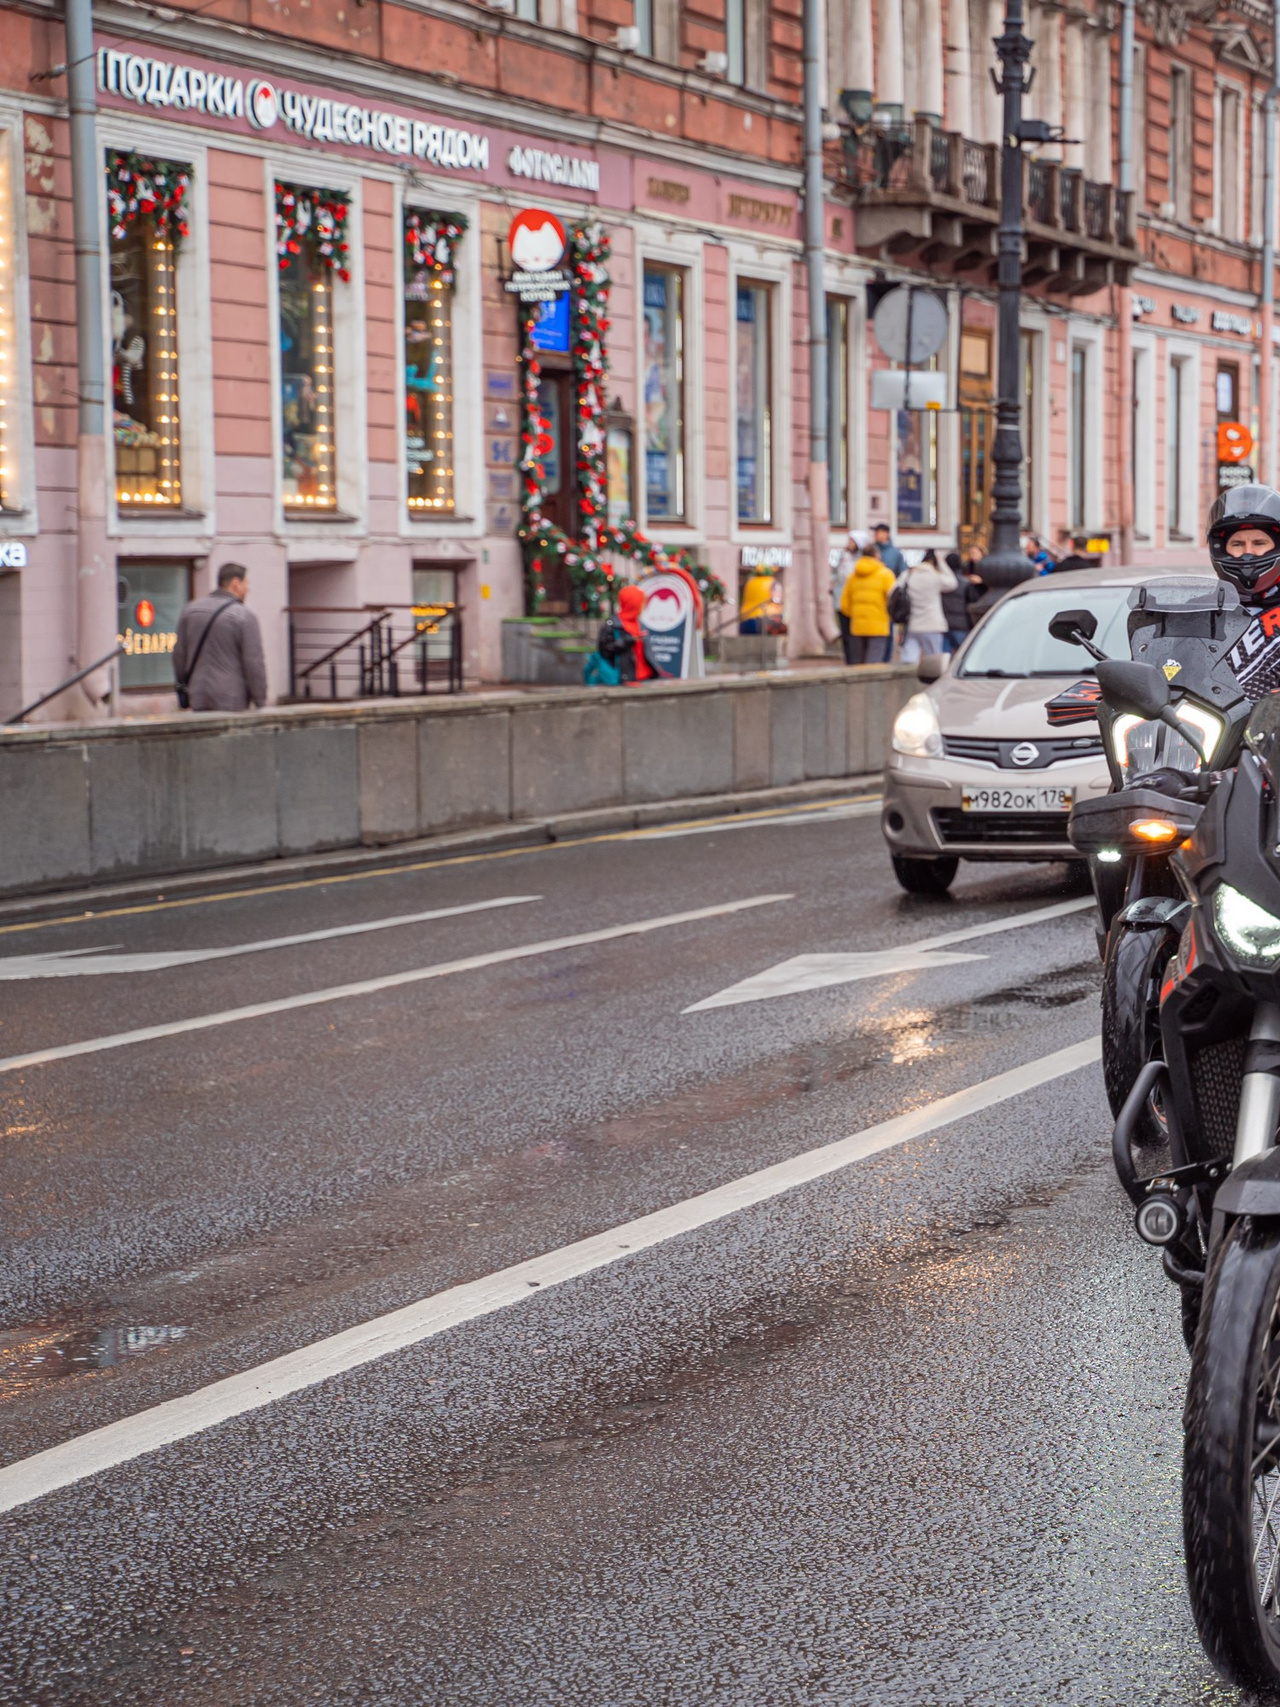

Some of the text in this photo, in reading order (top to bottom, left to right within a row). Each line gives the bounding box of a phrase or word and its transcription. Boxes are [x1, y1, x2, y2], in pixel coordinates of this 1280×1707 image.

[98, 47, 243, 119] ПОДАРКИ
[280, 90, 489, 171] ЧУДЕСНОЕ РЯДОМ
